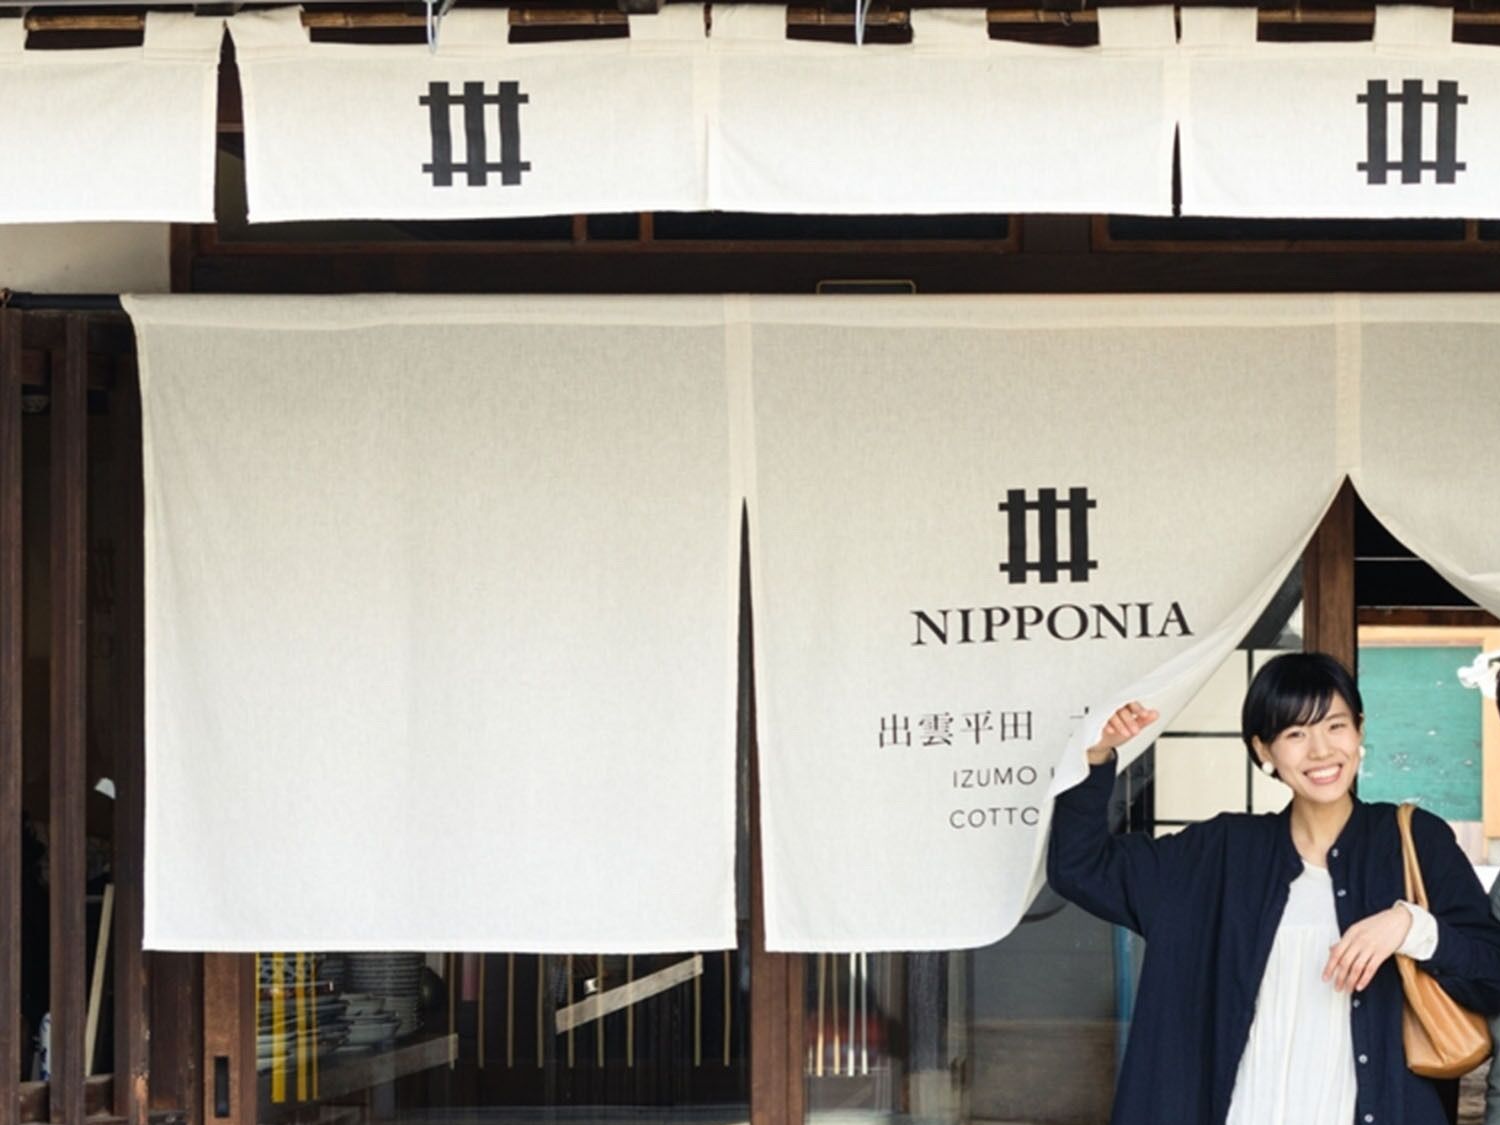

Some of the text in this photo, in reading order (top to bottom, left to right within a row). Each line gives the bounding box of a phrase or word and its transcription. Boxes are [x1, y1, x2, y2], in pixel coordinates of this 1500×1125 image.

[910, 600, 1195, 646] NIPPONIA
[878, 709, 1033, 748] 出雲平田
[952, 765, 1038, 789] IZUMO
